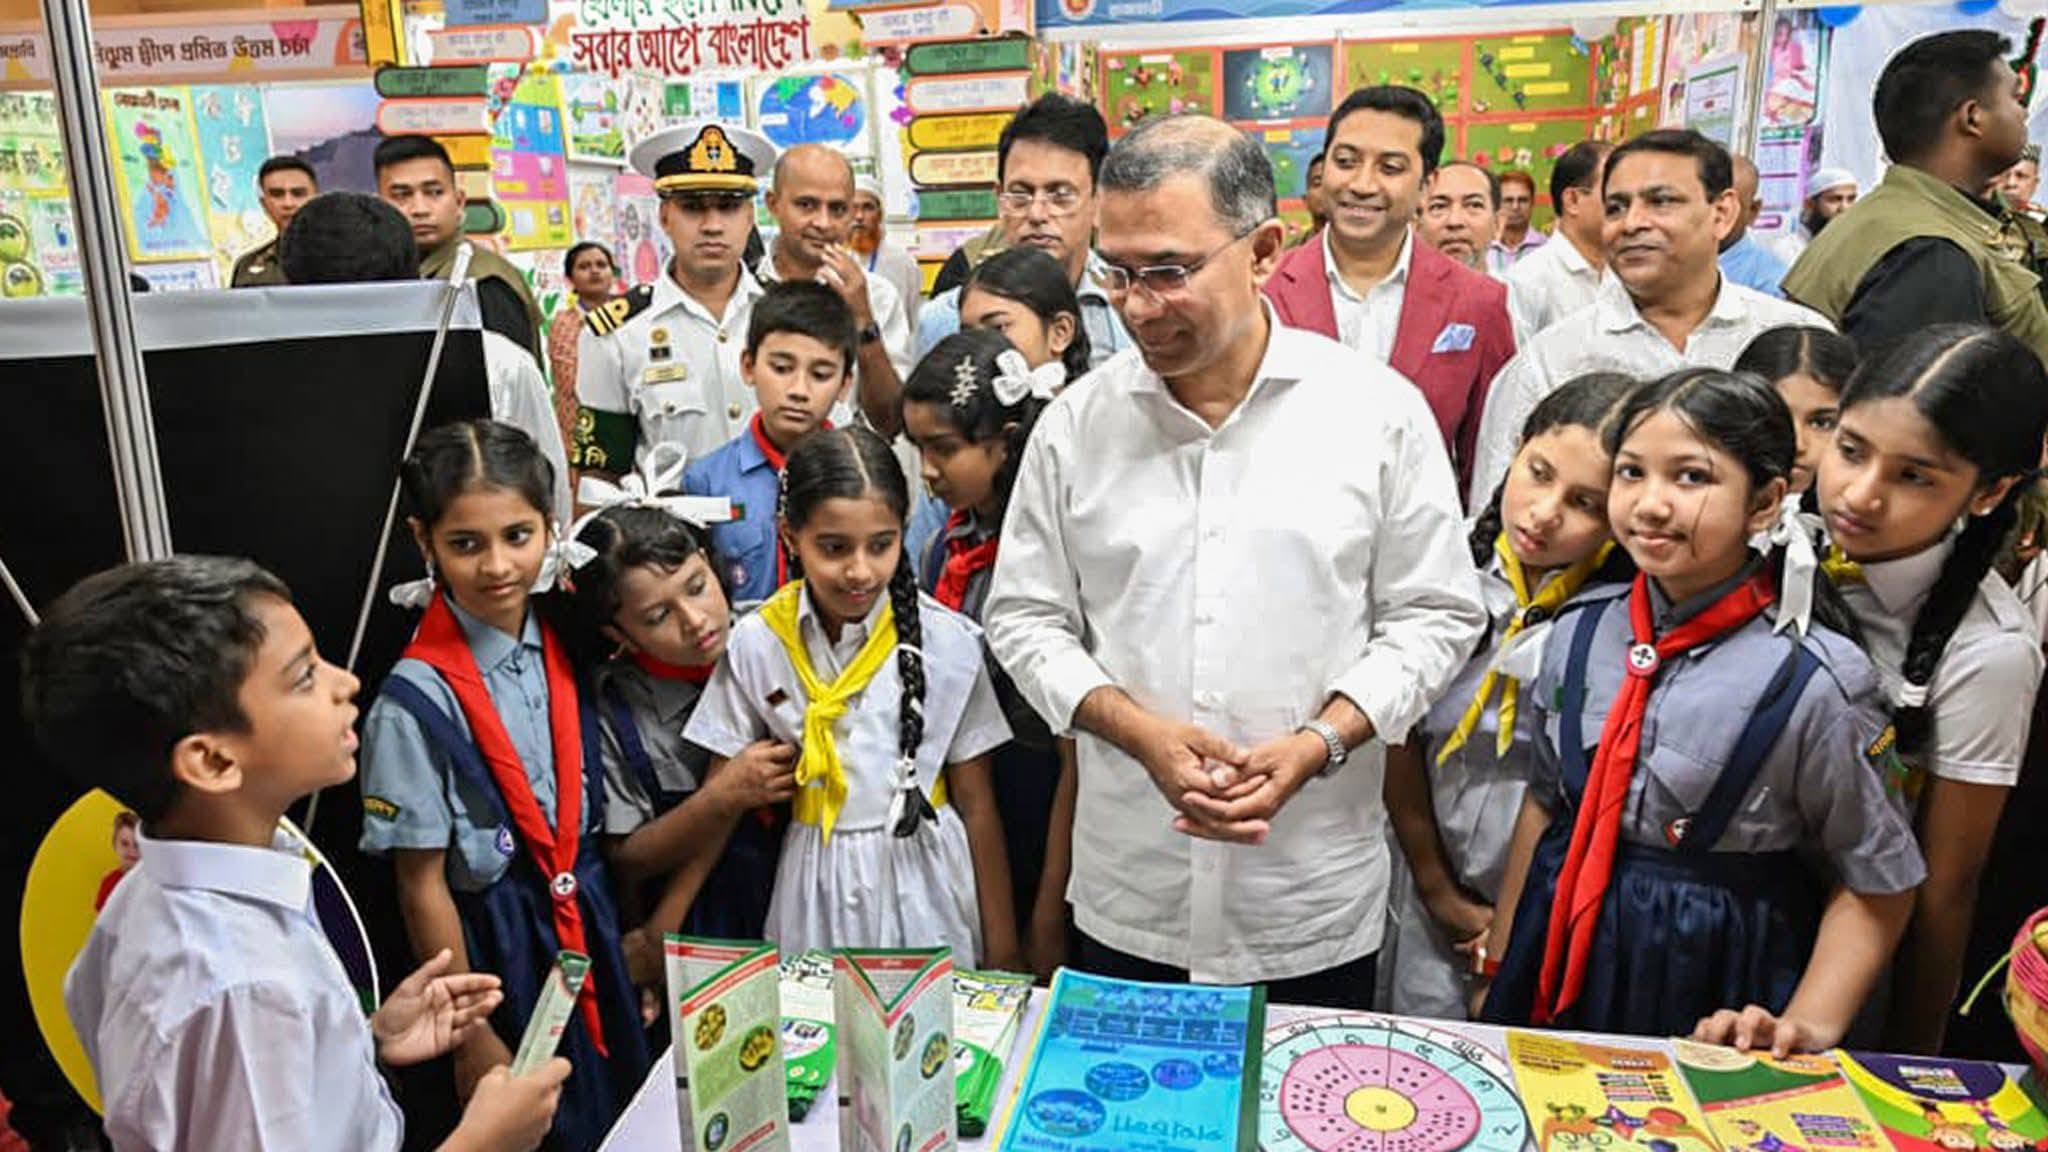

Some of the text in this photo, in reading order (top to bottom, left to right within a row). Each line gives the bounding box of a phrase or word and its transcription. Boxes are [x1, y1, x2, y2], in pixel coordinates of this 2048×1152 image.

[179, 35, 228, 62] প্রমিত
[572, 27, 633, 79] সবার
[635, 21, 701, 76] আগে
[707, 14, 812, 71] বাংলাদেশ
